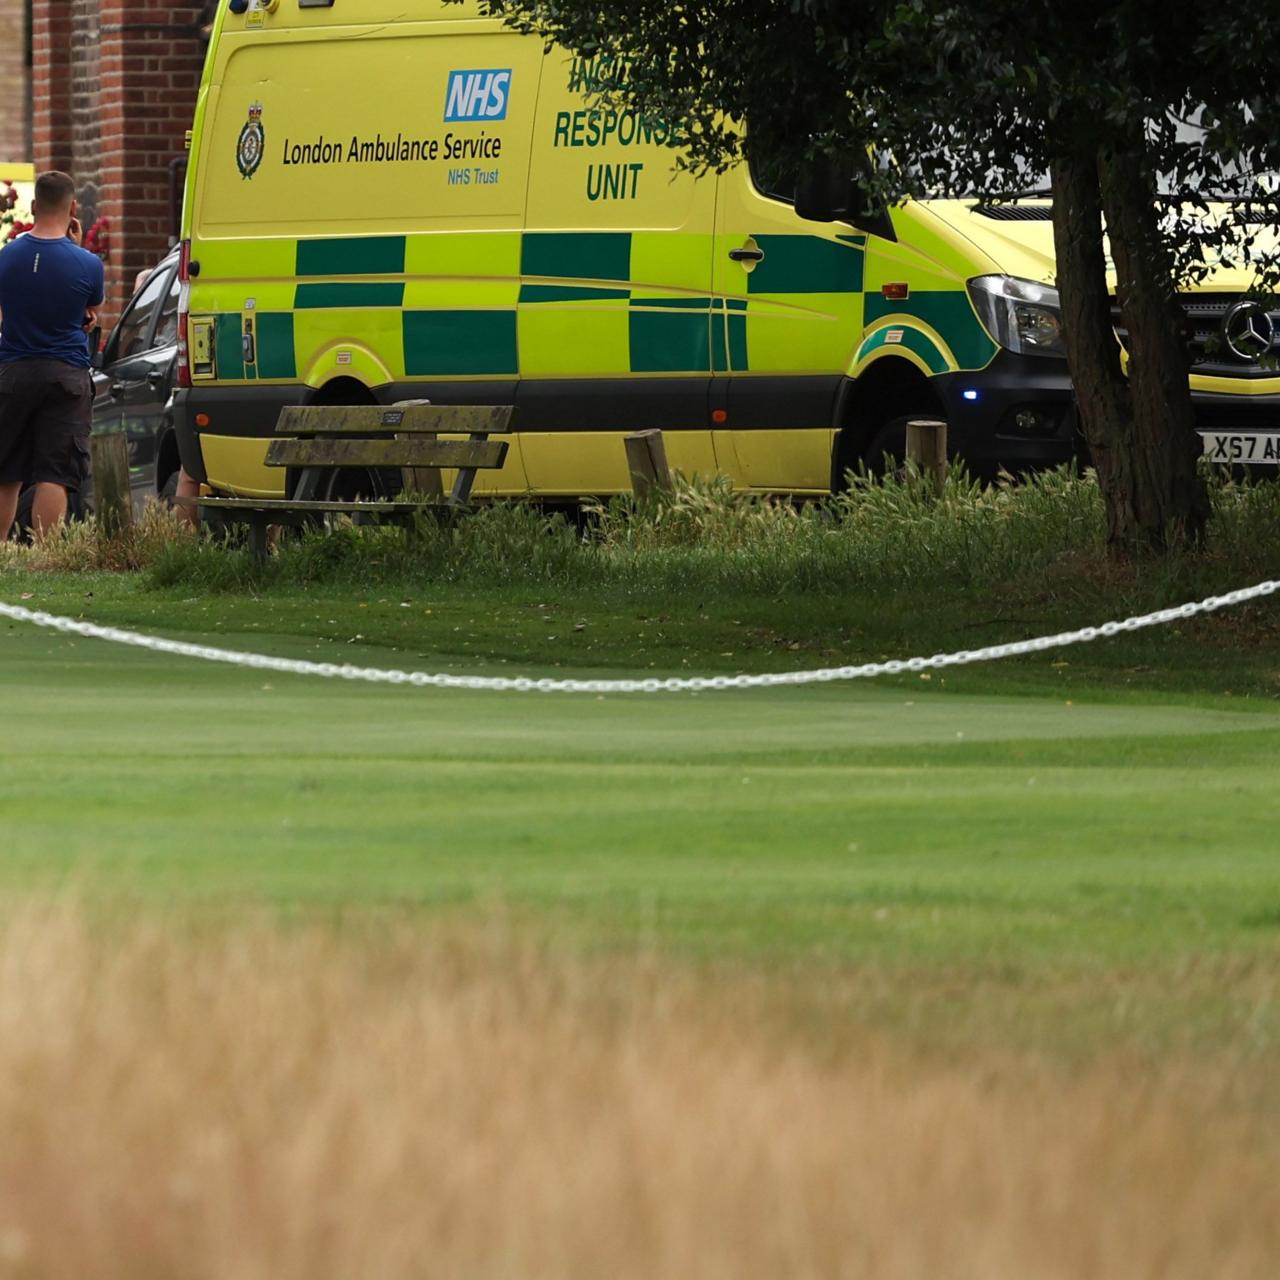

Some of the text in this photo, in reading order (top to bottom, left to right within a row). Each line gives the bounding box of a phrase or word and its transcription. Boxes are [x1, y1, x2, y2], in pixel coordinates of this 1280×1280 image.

[445, 72, 510, 119] NHS
[283, 130, 502, 165] London Ambulance Service
[554, 110, 684, 148] RESPONSE
[448, 168, 499, 185] NHS Trust
[587, 163, 644, 202] UNIT
